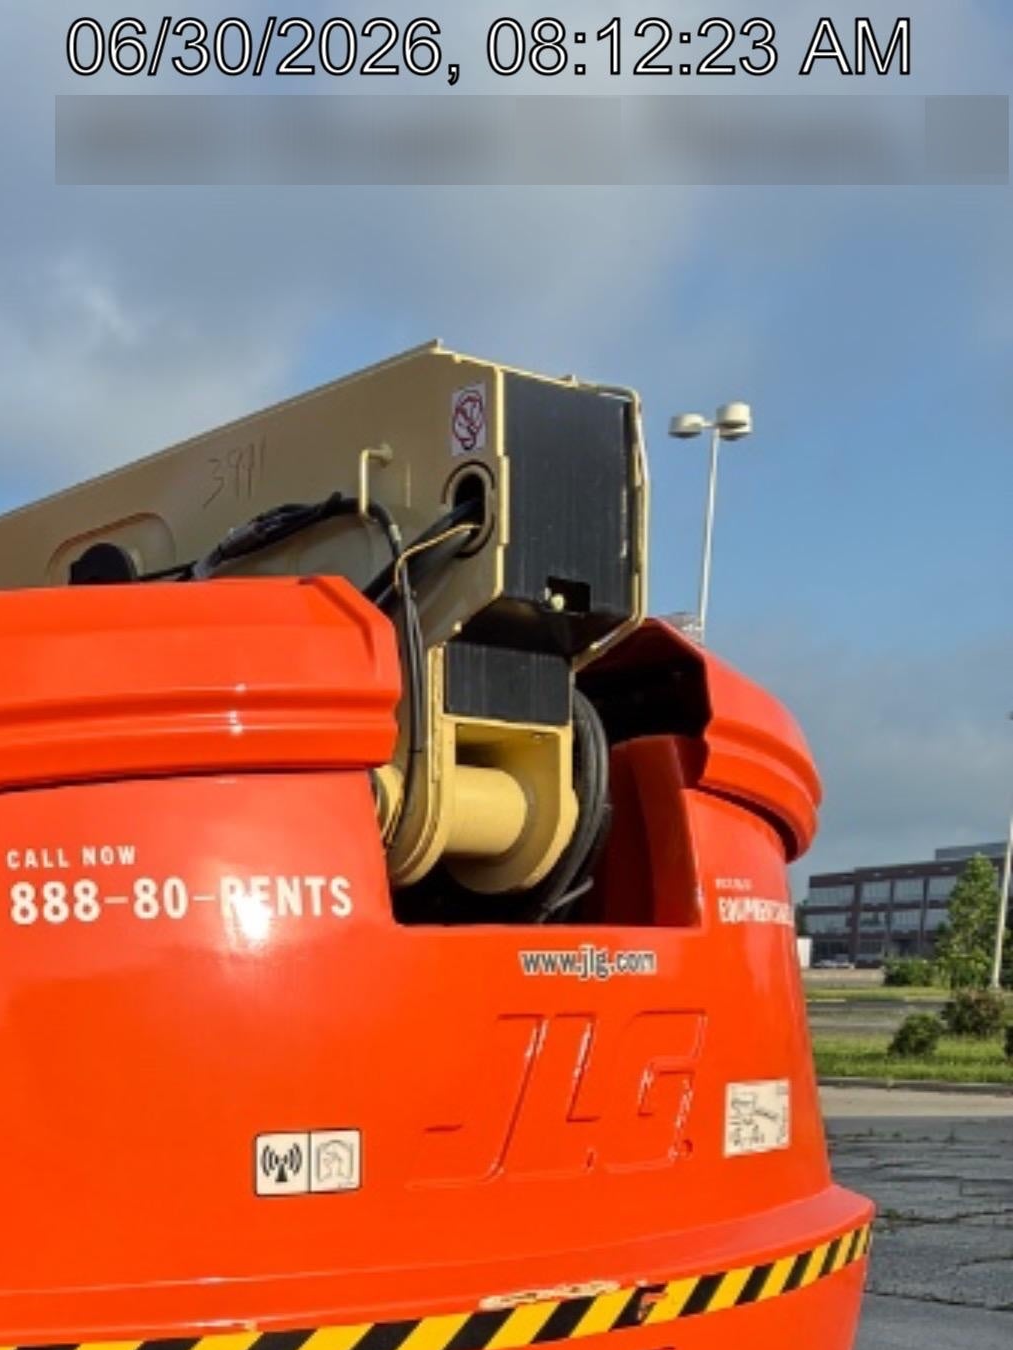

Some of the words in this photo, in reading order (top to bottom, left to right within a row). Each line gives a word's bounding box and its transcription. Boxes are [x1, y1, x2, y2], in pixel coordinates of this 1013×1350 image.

[6, 847, 70, 869] CALL
[82, 845, 136, 866] NOW
[10, 875, 353, 925] 888-80-RENTS
[519, 944, 656, 981] www.jlg.com
